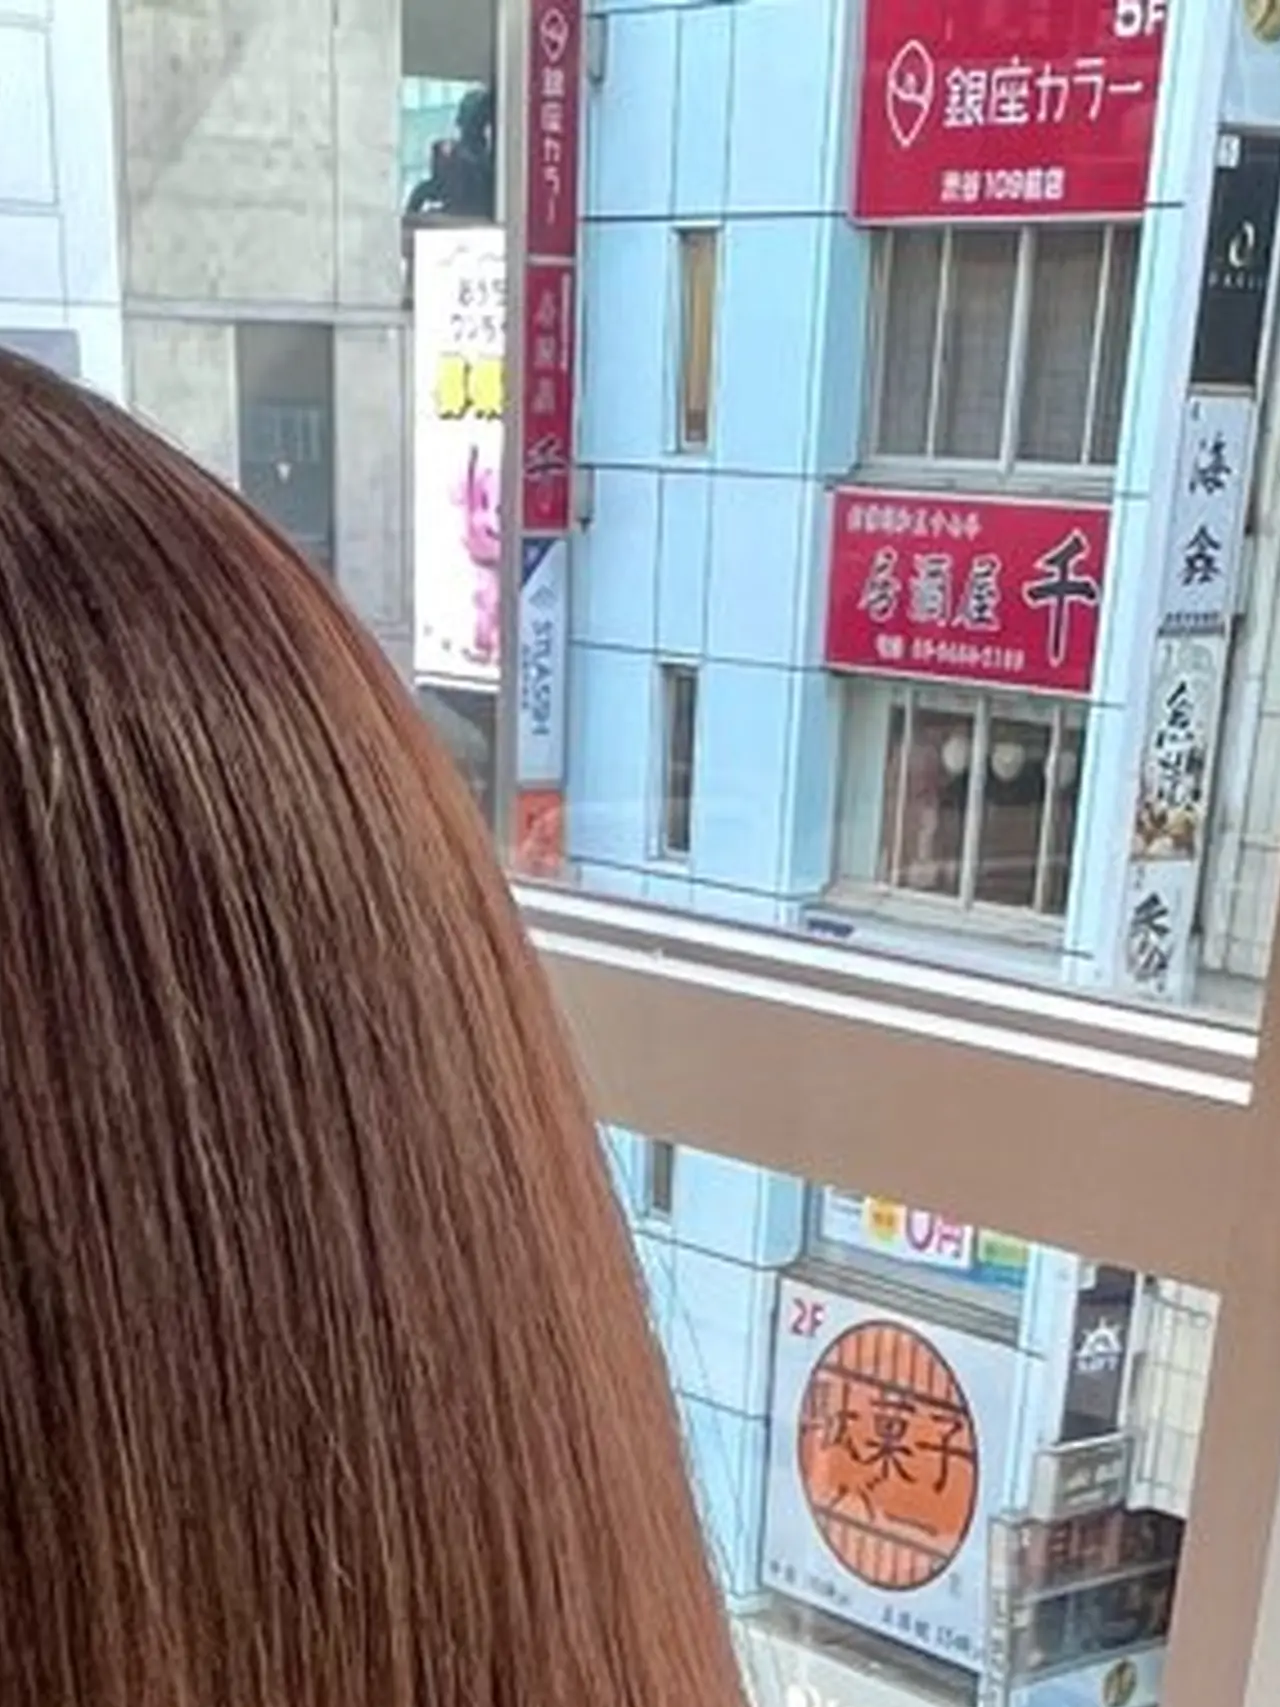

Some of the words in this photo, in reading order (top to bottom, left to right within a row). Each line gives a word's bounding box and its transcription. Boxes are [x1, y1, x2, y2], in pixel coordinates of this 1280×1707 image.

[942, 55, 1144, 129] 銀座カラー
[1023, 528, 1100, 668] 千
[791, 1297, 825, 1336] 2F
